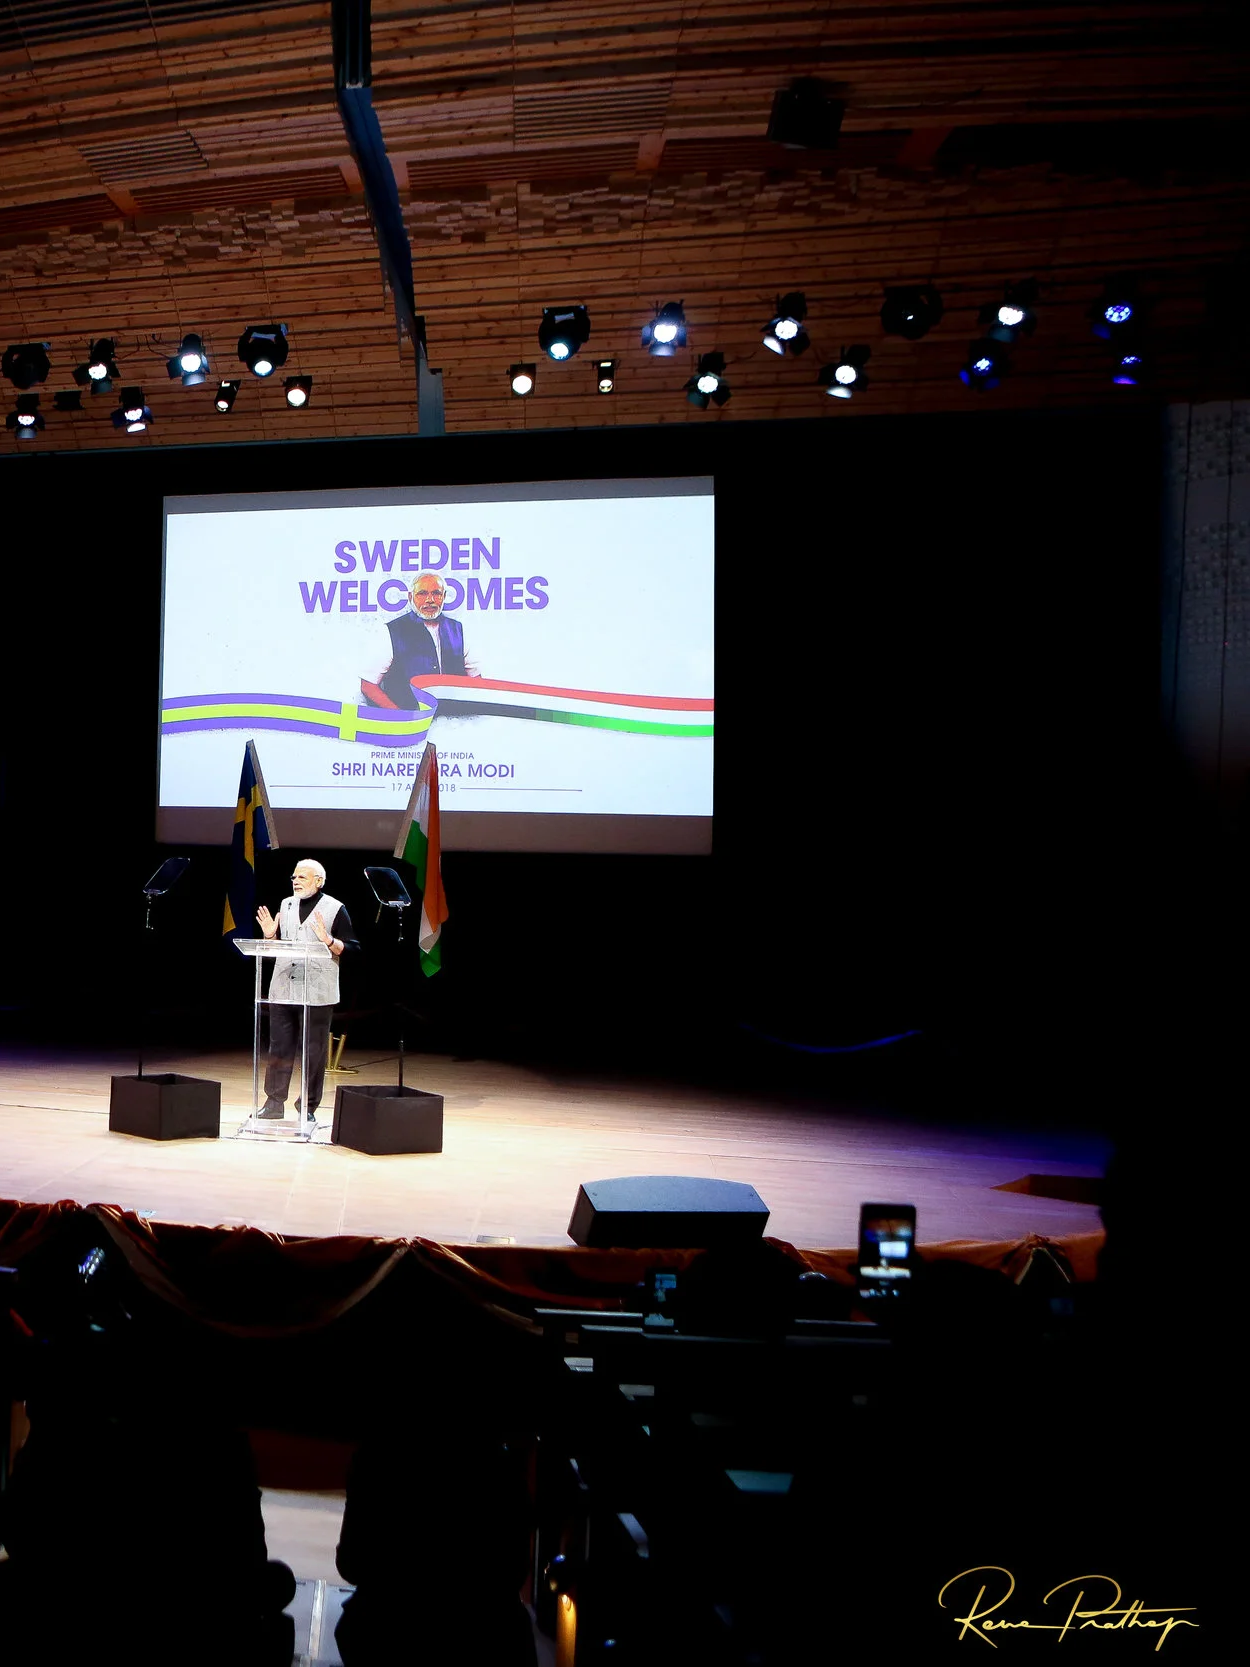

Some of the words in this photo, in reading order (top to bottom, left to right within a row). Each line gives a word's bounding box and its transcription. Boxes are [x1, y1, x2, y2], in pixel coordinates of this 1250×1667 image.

[334, 537, 501, 574] SWEDEN
[370, 751, 396, 759] PRIME
[397, 751, 424, 760] MINIS
[436, 752, 449, 760] OF
[450, 752, 475, 760] INDIA
[331, 762, 366, 776] SHRI
[371, 762, 463, 777] NARERA
[467, 764, 515, 778] MODI
[392, 782, 403, 792] 17
[437, 783, 456, 793] 018
